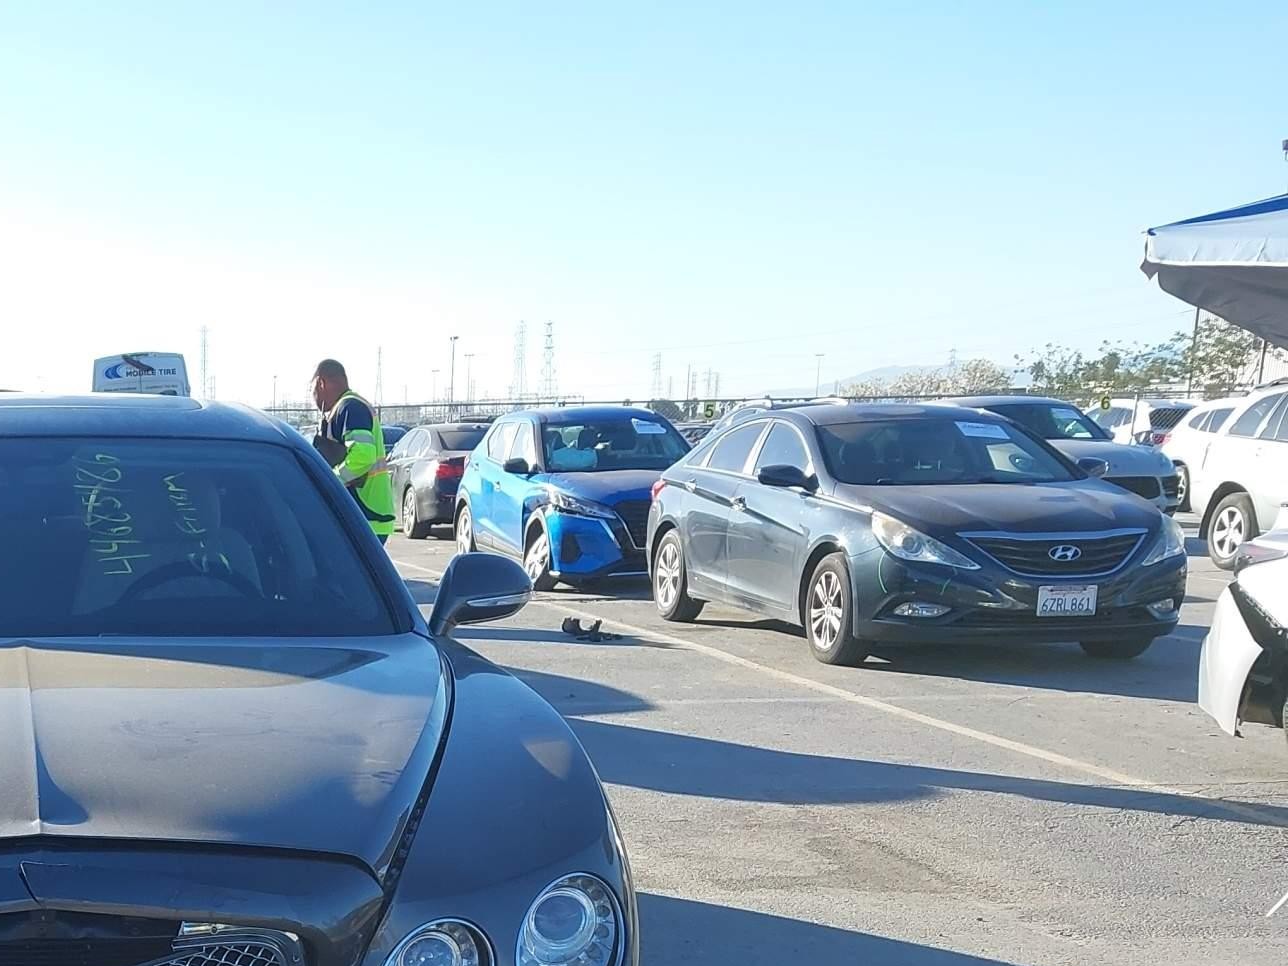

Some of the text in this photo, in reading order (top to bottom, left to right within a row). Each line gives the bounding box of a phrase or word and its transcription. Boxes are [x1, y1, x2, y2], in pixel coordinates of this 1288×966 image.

[158, 367, 177, 376] TIRE
[1101, 396, 1110, 410] 6
[705, 404, 714, 418] 5
[72, 453, 152, 575] 44685486
